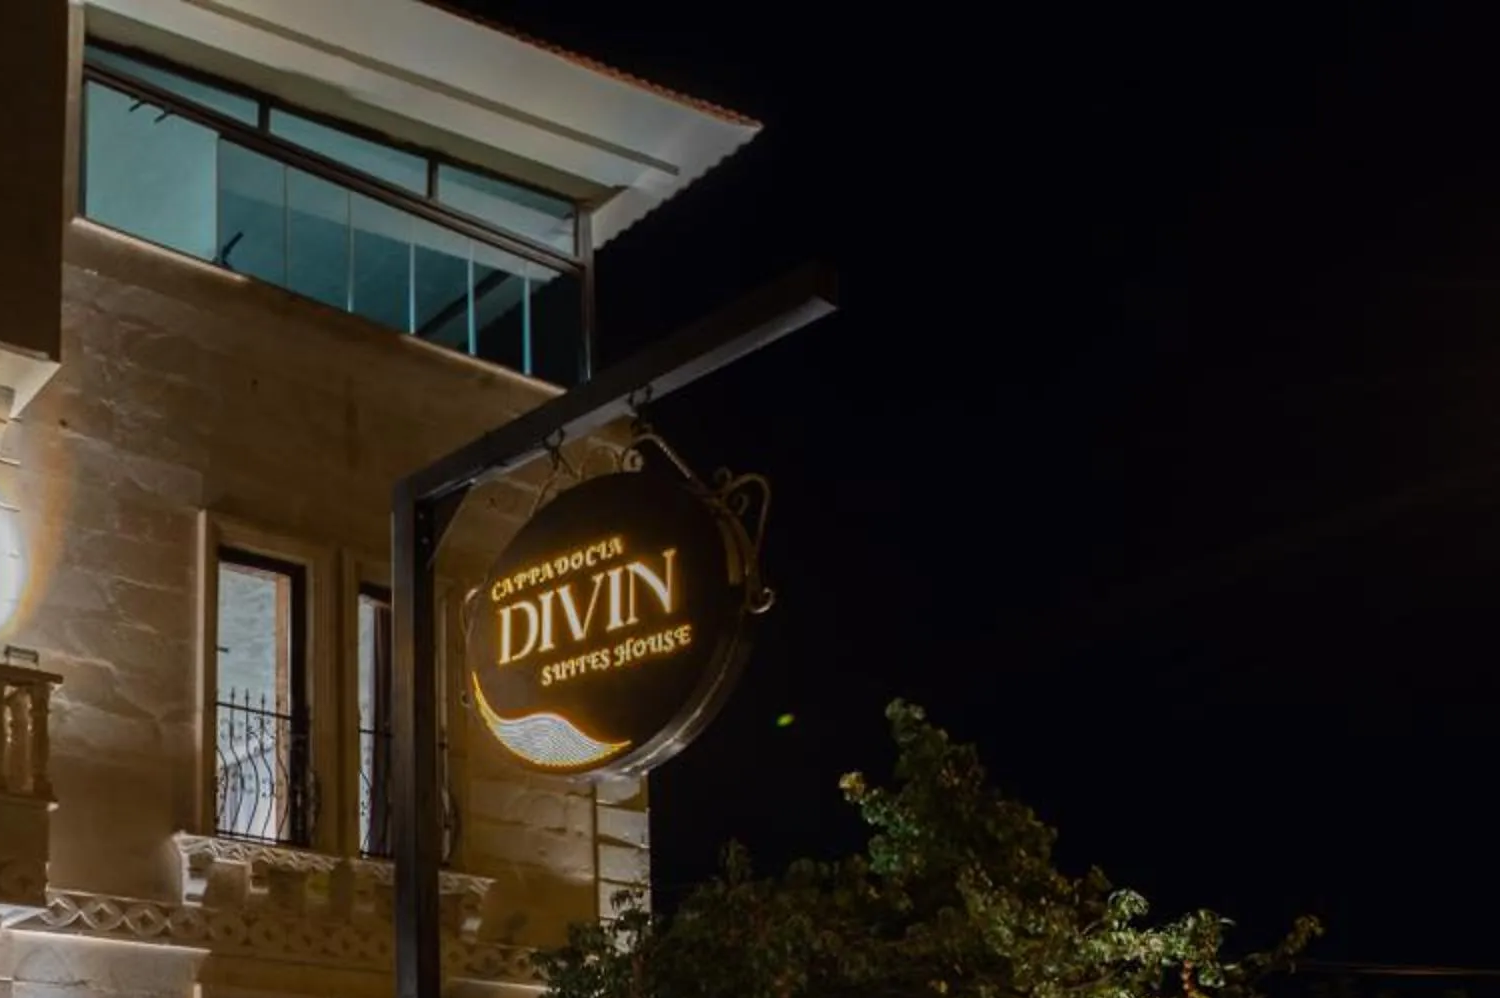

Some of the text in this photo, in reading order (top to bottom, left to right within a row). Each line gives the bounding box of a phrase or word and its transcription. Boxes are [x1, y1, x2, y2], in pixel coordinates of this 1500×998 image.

[491, 536, 624, 602] CAPPADOCIA
[498, 547, 677, 665] DIVIN
[541, 623, 692, 687] SUITES HOUSE
